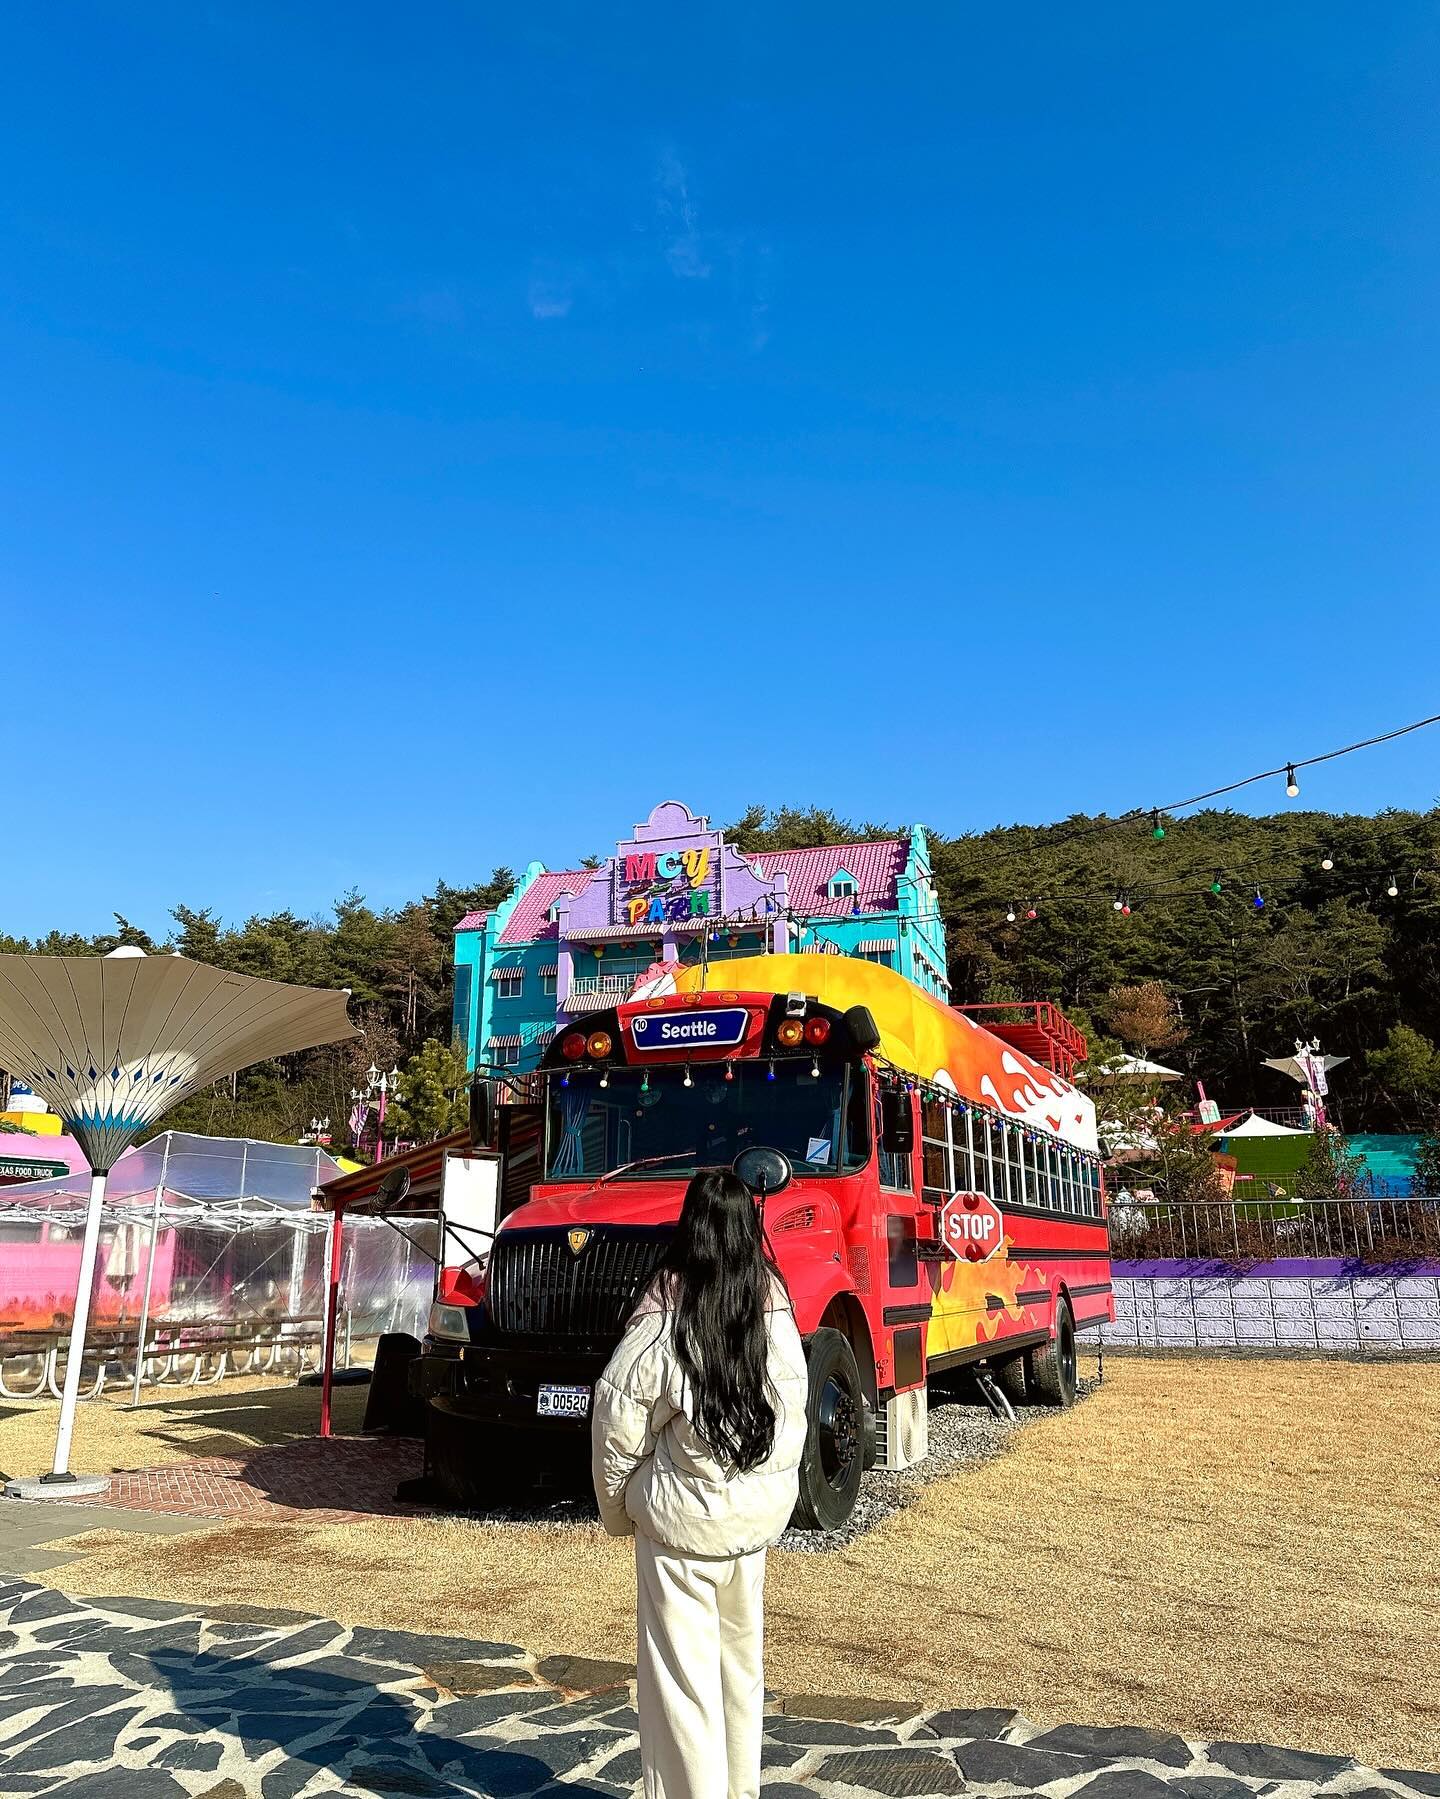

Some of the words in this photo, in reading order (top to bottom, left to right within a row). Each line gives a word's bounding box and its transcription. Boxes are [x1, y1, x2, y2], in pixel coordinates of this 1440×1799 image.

[637, 1020, 646, 1030] 10
[661, 1020, 717, 1039] Seattle
[15, 1166, 32, 1176] FOOD
[33, 1168, 54, 1177] TRUCK
[949, 1213, 996, 1240] STOP
[552, 1393, 587, 1411] 00520
